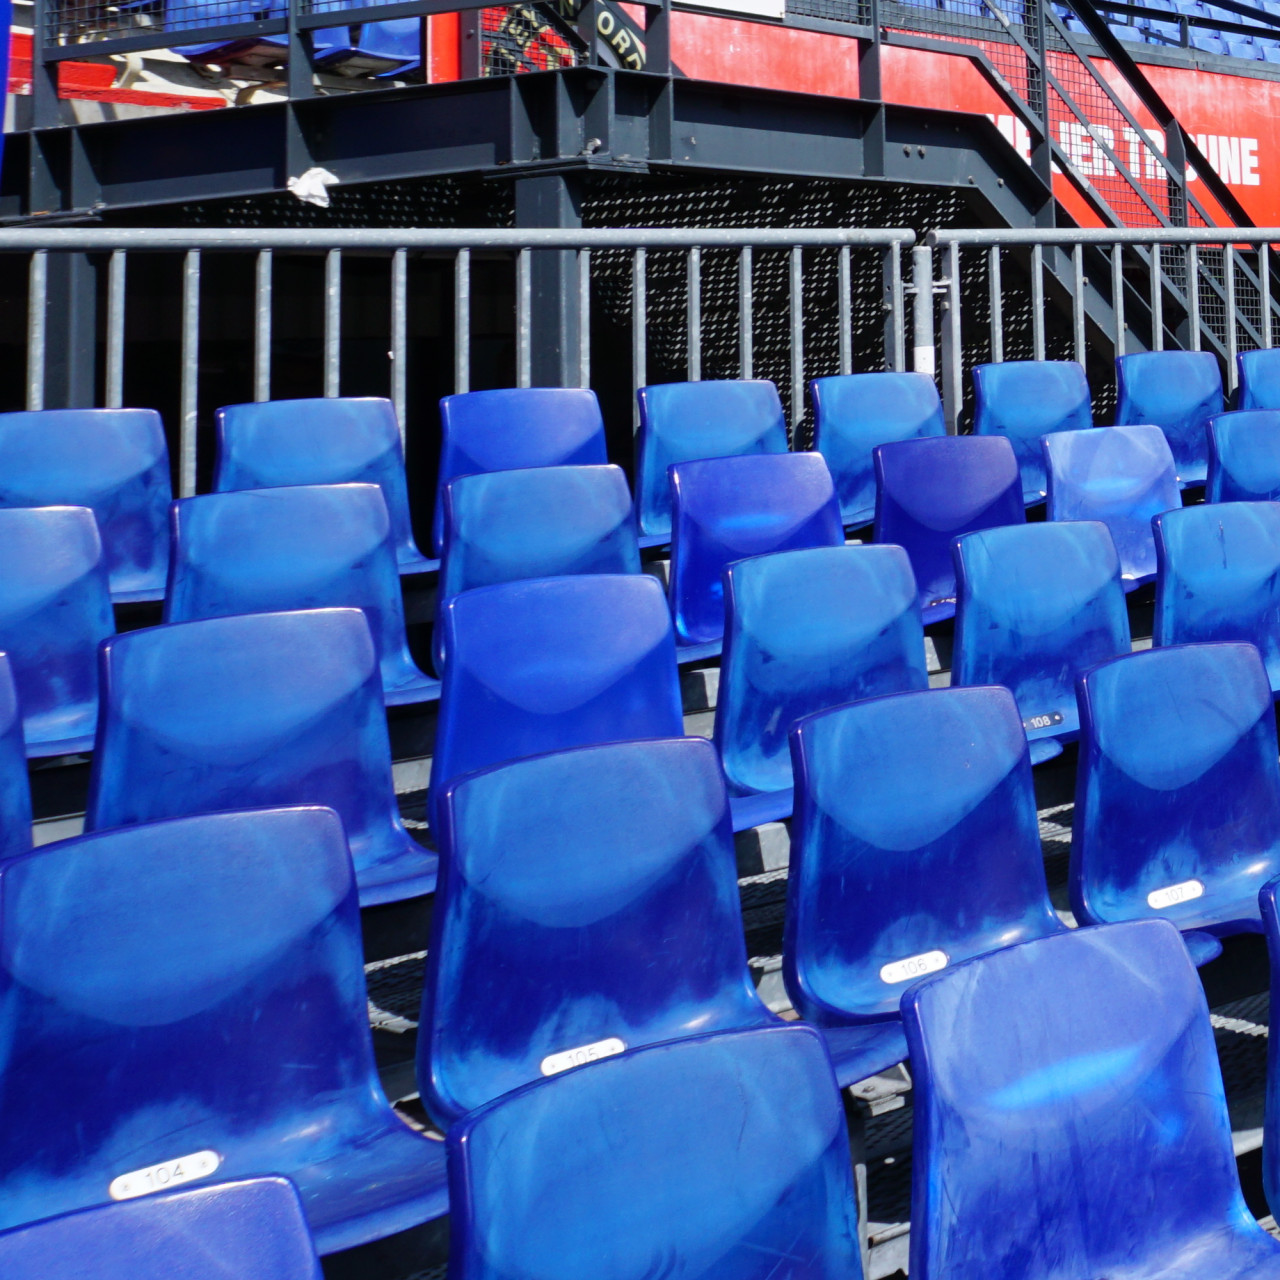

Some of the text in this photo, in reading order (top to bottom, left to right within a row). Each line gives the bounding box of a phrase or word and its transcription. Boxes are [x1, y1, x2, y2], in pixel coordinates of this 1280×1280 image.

[985, 114, 1260, 186] EJER TRUNE
[1030, 715, 1051, 728] 108
[1165, 887, 1184, 902] 107
[902, 958, 928, 976] 106
[568, 1049, 600, 1066] 105
[147, 1163, 187, 1188] 104
